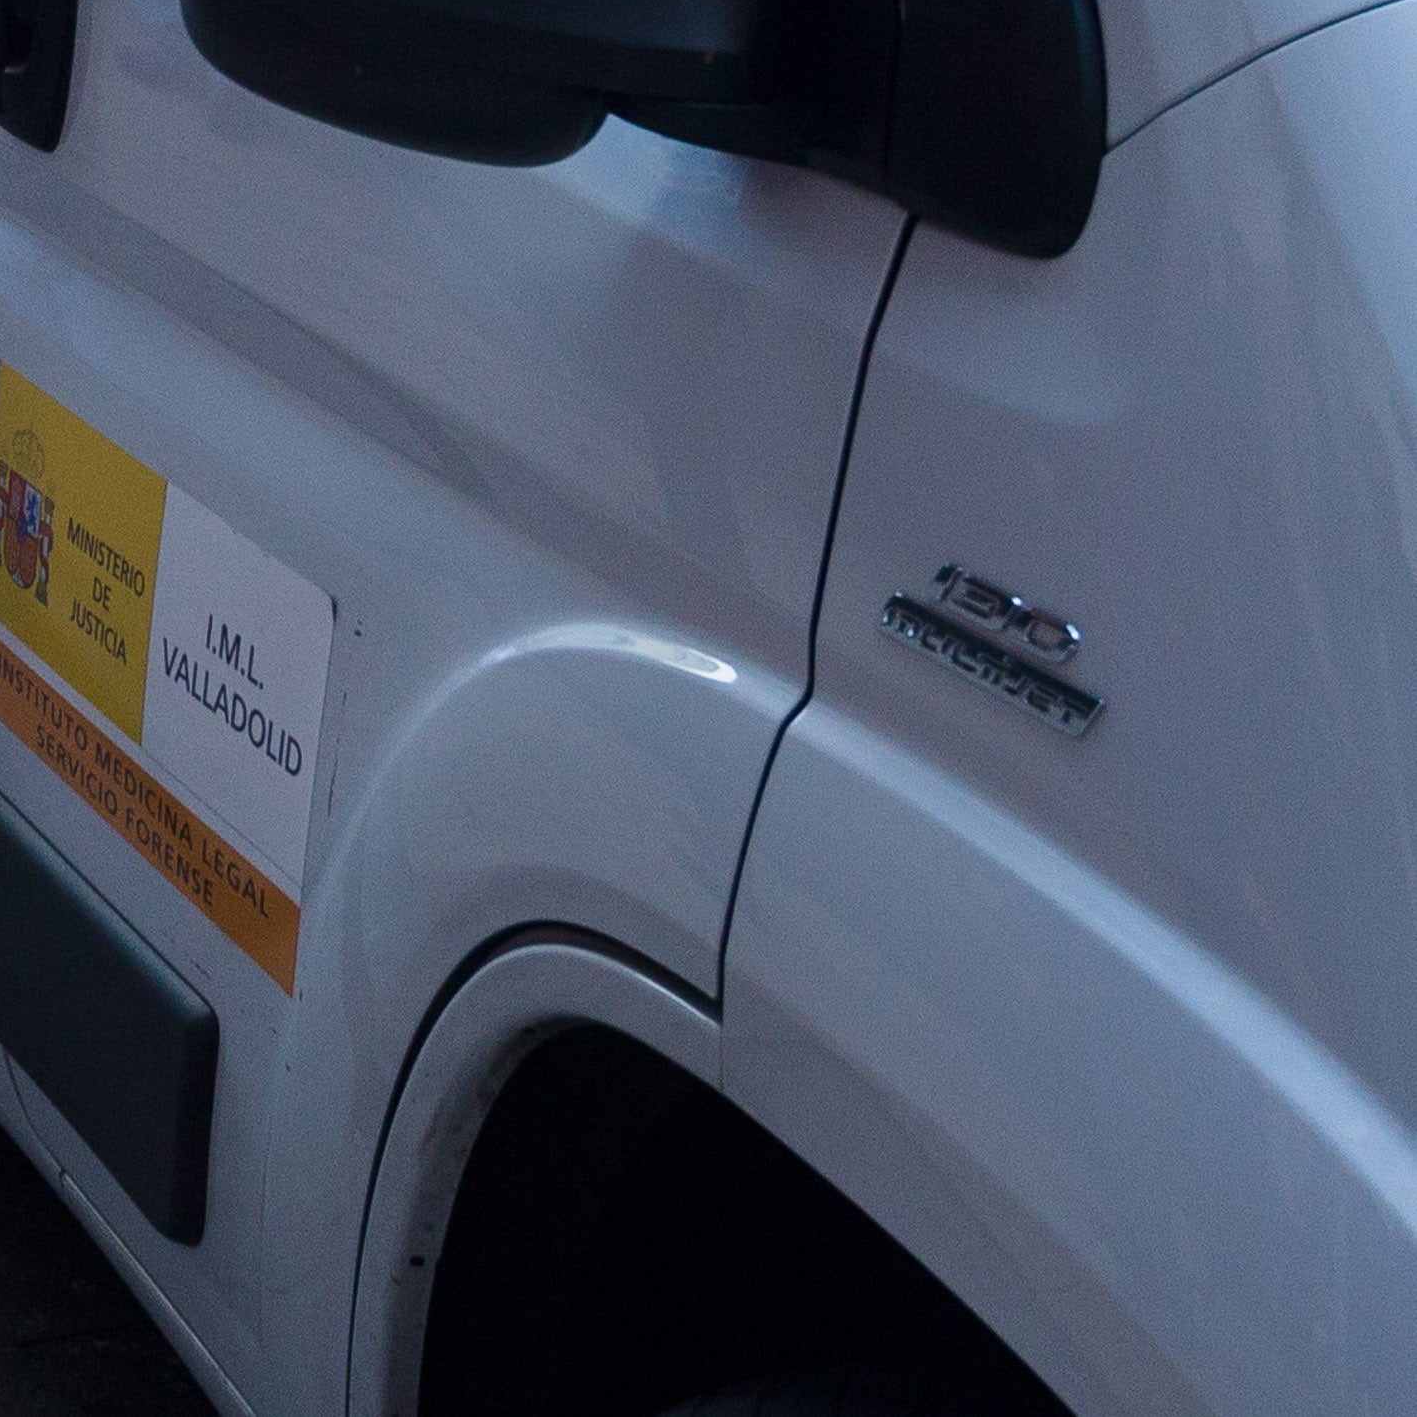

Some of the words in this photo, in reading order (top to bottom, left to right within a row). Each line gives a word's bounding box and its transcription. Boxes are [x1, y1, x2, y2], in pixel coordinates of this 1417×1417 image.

[67, 517, 146, 598] MINISTERIO
[92, 577, 112, 612] DE
[70, 597, 128, 667] JUSTICIA
[205, 613, 264, 690] I.M.L.
[163, 637, 303, 777] VALLADOLID
[36, 725, 118, 815] SERVICIO
[125, 807, 214, 908] FORENSE
[95, 741, 194, 851] MEDICINA
[201, 839, 269, 919] LEGAL
